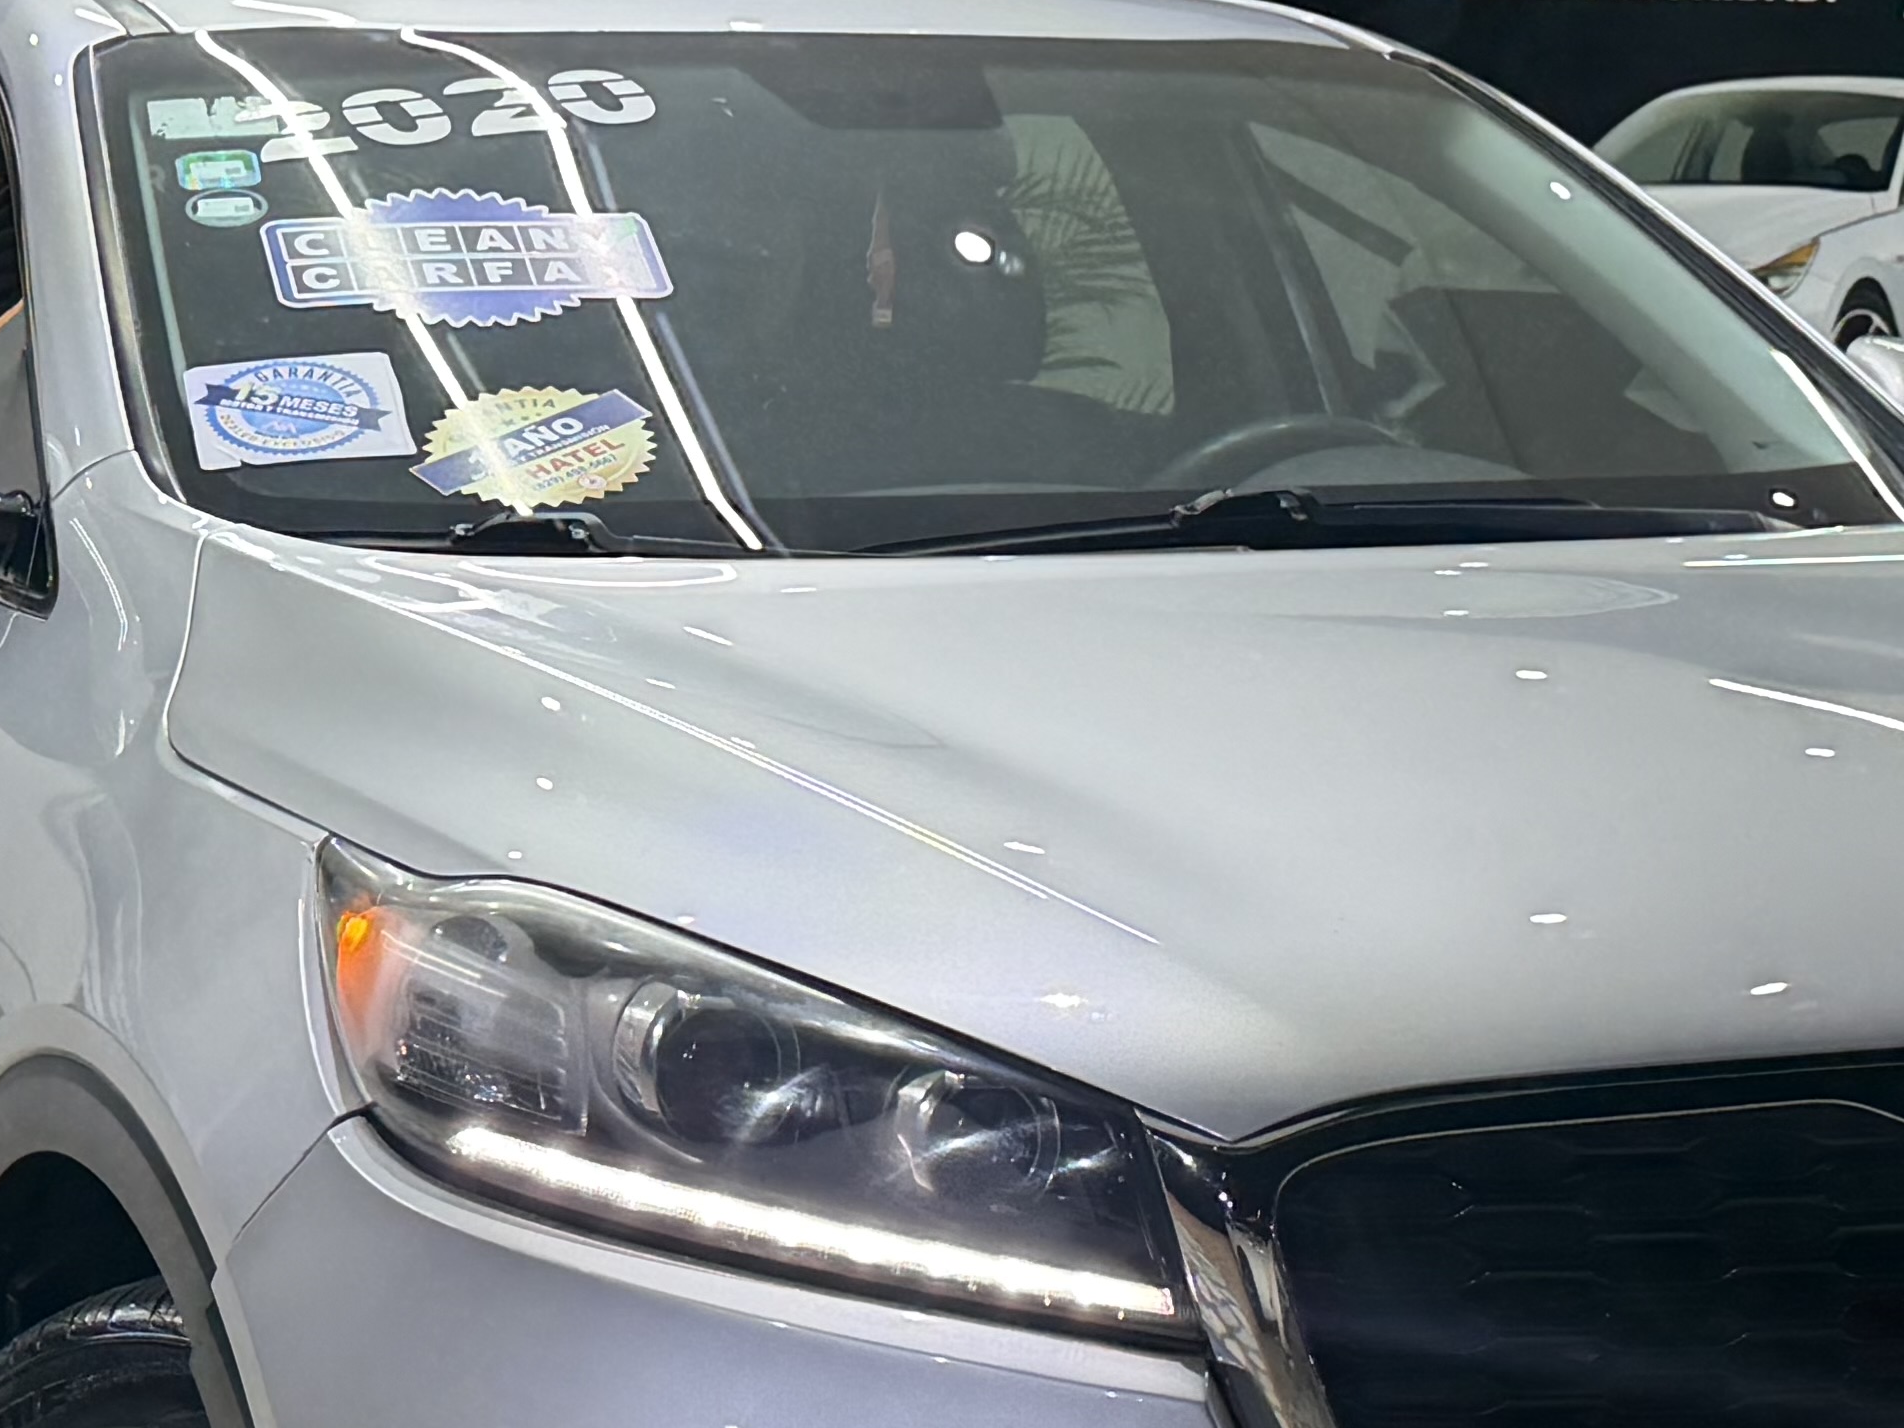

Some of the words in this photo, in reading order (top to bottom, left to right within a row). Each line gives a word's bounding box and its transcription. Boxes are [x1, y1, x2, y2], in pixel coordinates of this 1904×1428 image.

[234, 69, 656, 164] 2020
[279, 395, 360, 419] MESES
[503, 417, 584, 458] AÑO
[526, 439, 626, 480] HATEL
